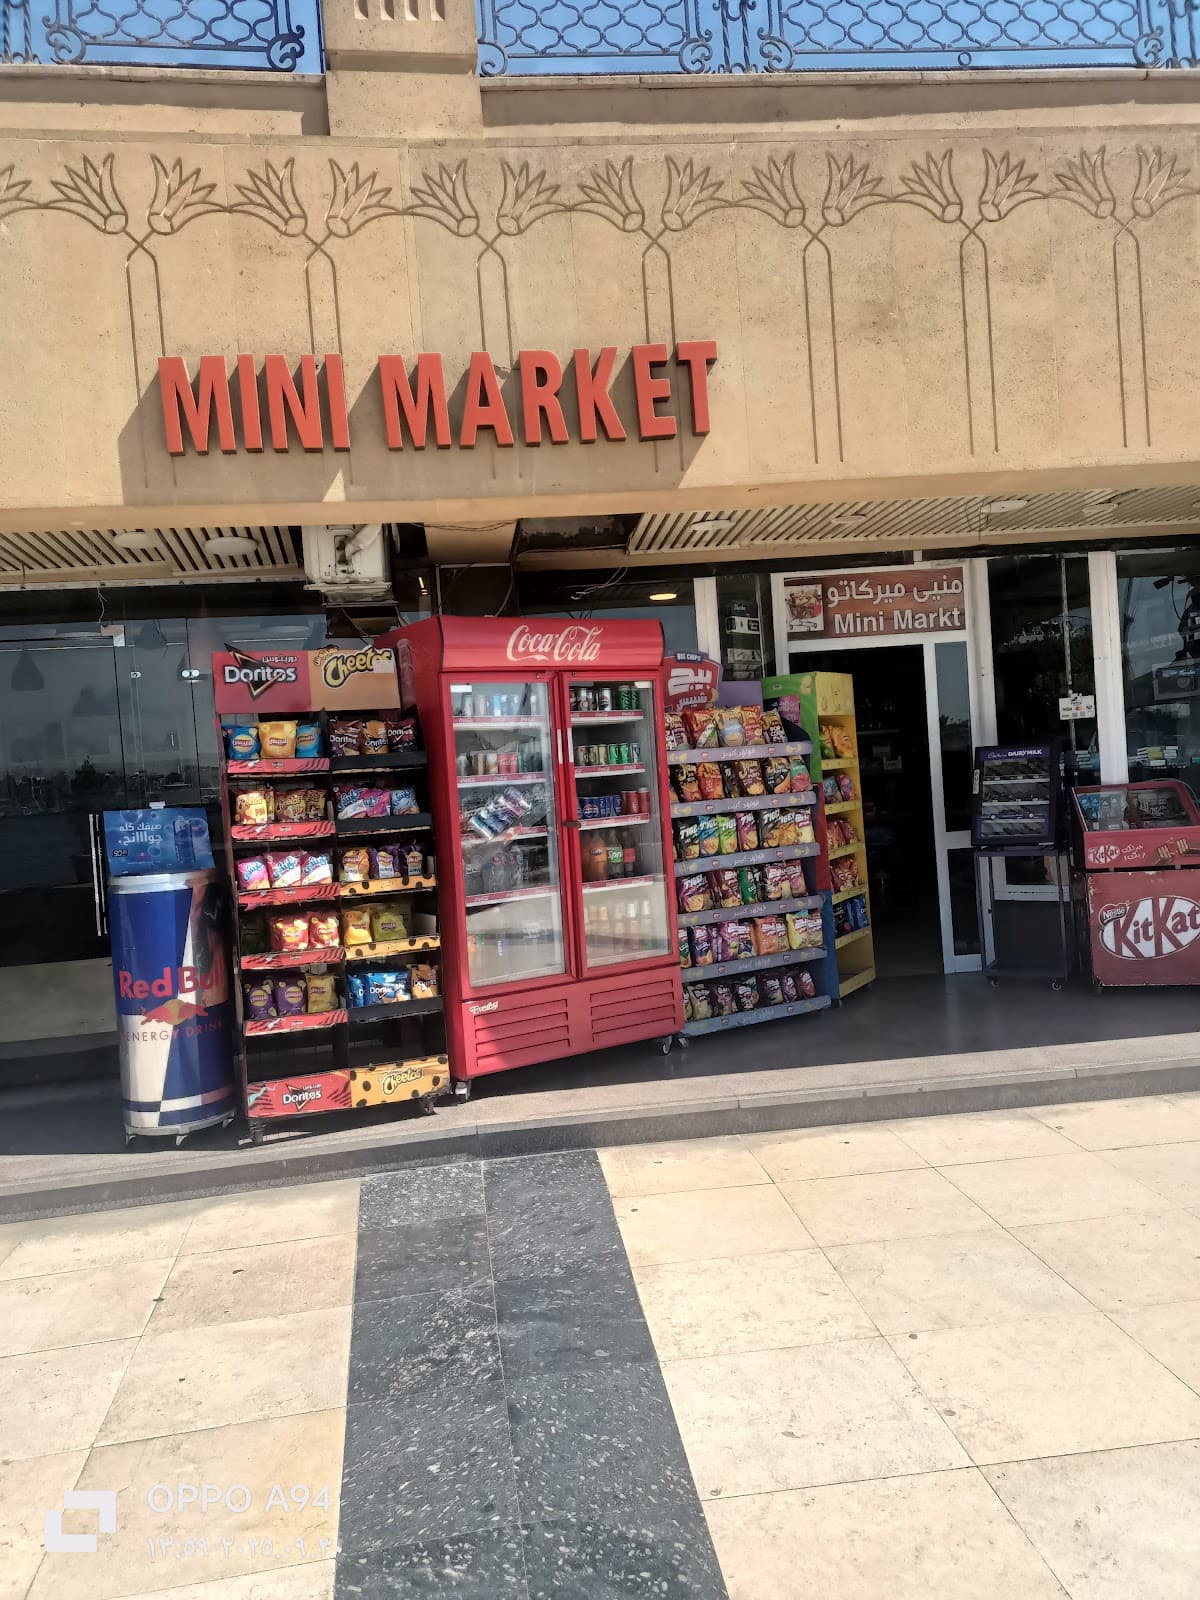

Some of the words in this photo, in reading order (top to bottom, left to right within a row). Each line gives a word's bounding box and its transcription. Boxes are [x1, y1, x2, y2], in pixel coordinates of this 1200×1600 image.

[158, 353, 351, 457] MINI
[378, 340, 718, 451] MARKET
[834, 612, 885, 634] Mini
[893, 606, 962, 631] Markt
[224, 665, 298, 684] Doritos
[329, 734, 357, 744] Doritos
[1091, 845, 1120, 864] KitKat
[1113, 896, 1200, 959] KitKat
[118, 966, 173, 999] Red
[178, 965, 225, 994] Bull
[125, 1024, 180, 1042] ENERGY
[383, 1067, 423, 1095] Cheetos
[283, 1090, 322, 1105] Doritos
